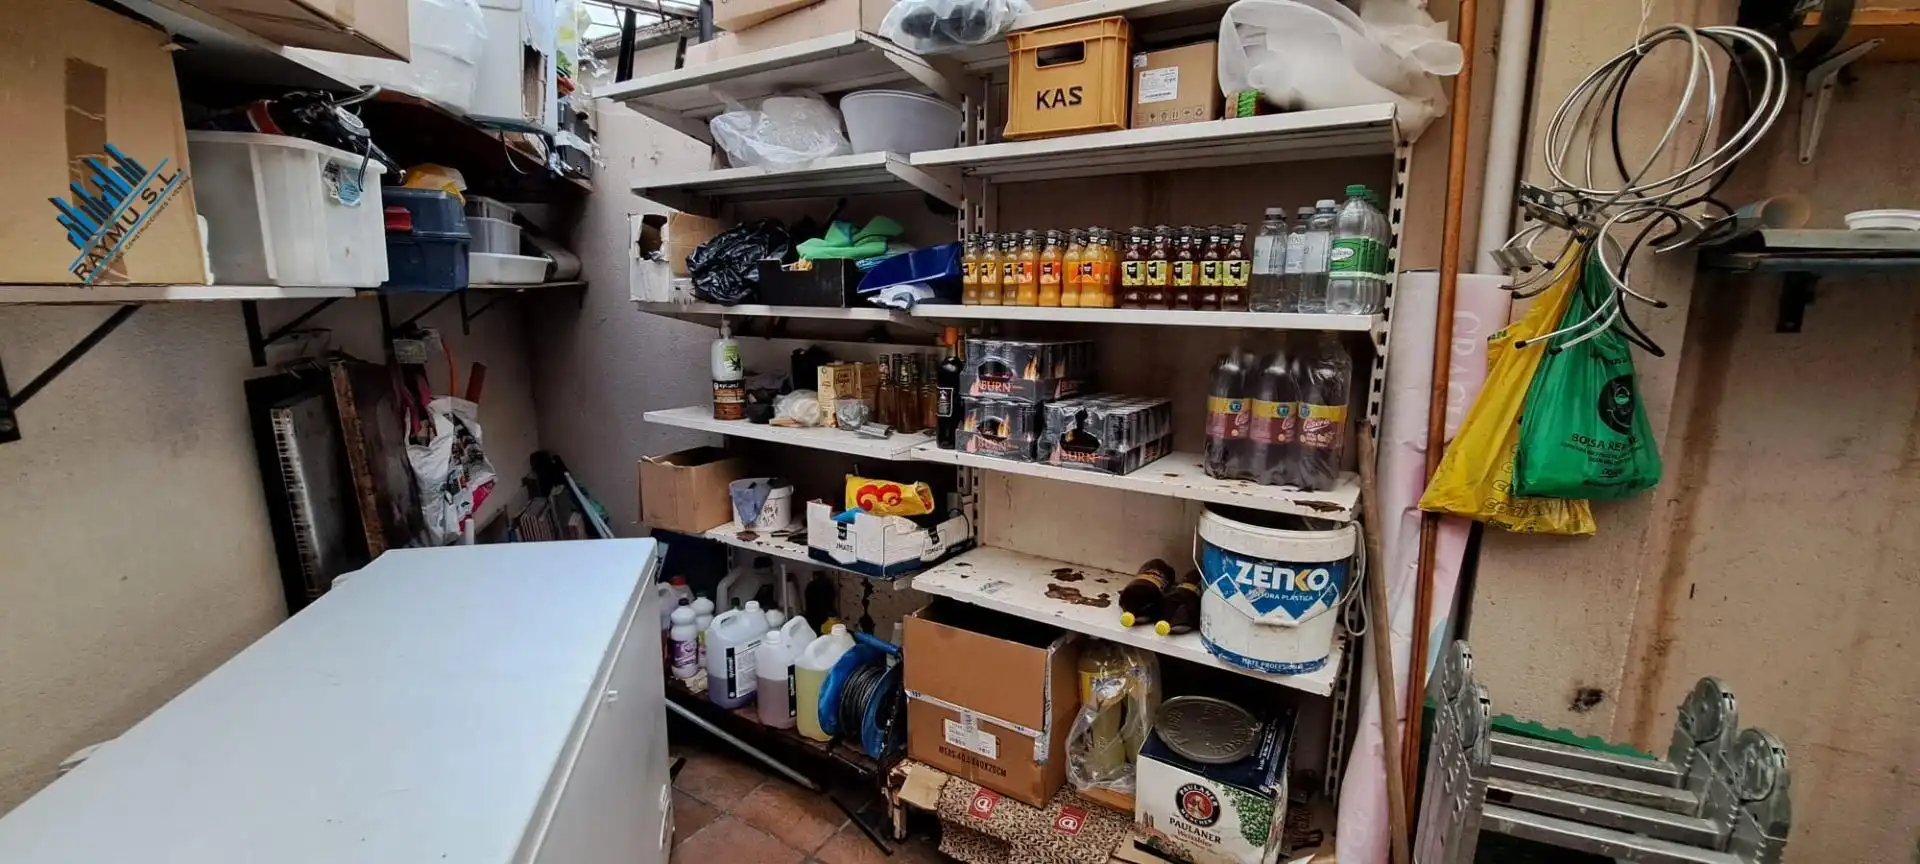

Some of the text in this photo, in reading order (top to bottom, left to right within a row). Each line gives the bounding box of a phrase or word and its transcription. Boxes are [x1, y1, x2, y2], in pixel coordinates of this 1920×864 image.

[1036, 86, 1083, 110] KAS
[979, 380, 1011, 393] BURN
[1235, 560, 1330, 592] ZENKO
[1179, 783, 1218, 807] PAULANER
[1169, 817, 1221, 844] PAULANER
